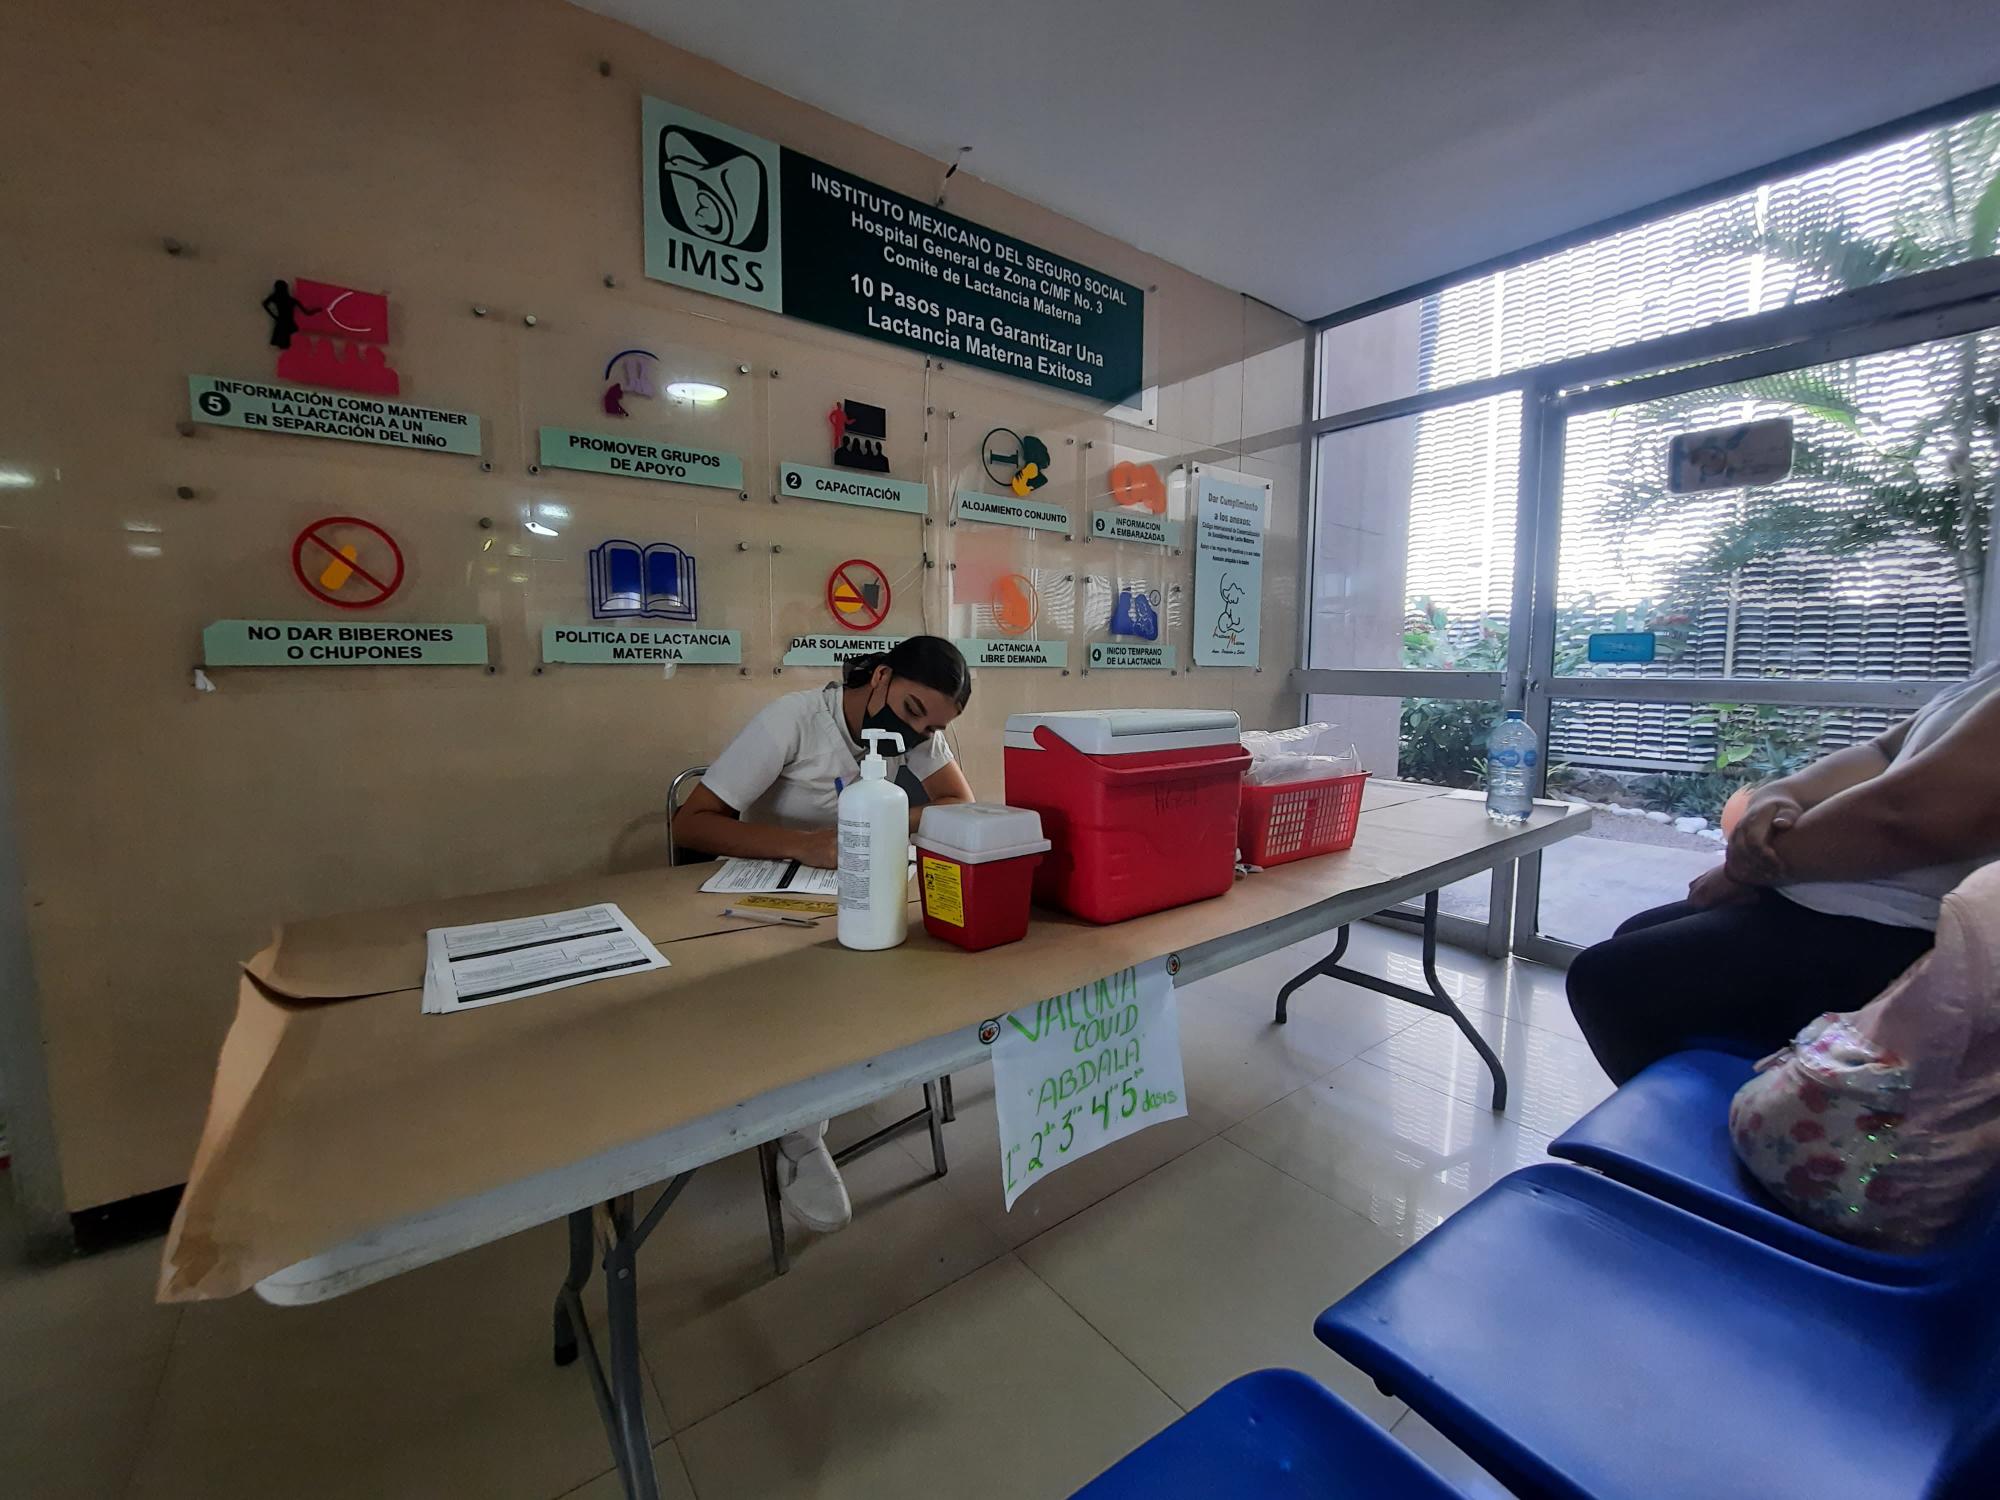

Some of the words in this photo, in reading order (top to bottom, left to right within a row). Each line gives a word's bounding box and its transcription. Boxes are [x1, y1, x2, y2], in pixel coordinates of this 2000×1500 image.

[811, 172, 903, 221] INSTITUTO
[908, 210, 991, 254] MEXICANO
[995, 243, 1023, 266] DEL
[1026, 255, 1081, 287] SEGURO
[1084, 277, 1127, 306] SOCIAL
[668, 238, 764, 292] IMSS
[851, 211, 918, 249] Hospital
[923, 238, 979, 271] General
[983, 260, 1000, 278] de
[1003, 266, 1036, 291] Zona
[1040, 280, 1071, 302] C/MF
[1074, 292, 1093, 312] No.
[1096, 301, 1103, 315] 3
[884, 246, 938, 277] Comite
[943, 268, 961, 285] de
[965, 274, 1030, 308] Lactancia
[1033, 297, 1082, 326] Materna
[851, 273, 874, 298] 10
[881, 282, 940, 318] Pasos
[946, 307, 985, 331] para
[991, 318, 1072, 357] Garantizar
[1077, 344, 1103, 367] Una
[868, 306, 960, 350] Lactancia
[966, 335, 1033, 370] Materna
[1038, 358, 1092, 387] Exitosa
[207, 391, 223, 412] 5
[214, 380, 333, 407] INFORMACIÓN
[337, 398, 384, 414] COMO
[388, 405, 468, 426] MANTENER
[272, 402, 294, 415] LA
[297, 405, 385, 427] LACTANCIA
[389, 417, 399, 429] A
[402, 419, 423, 432] UN
[244, 412, 267, 426] EN
[272, 415, 375, 440] SEPARACIÓN
[380, 429, 409, 443] DEL
[412, 432, 447, 448] NIÑO
[569, 435, 658, 459] PROMOVER
[660, 448, 720, 468] GRUPOS
[610, 457, 632, 471] DE
[634, 460, 686, 478] APOYO
[790, 475, 799, 487] 2
[815, 479, 901, 501] CAPACITACIÓN
[962, 500, 1022, 517] ALOJAMIENTO
[1024, 510, 1067, 524] CONJUNTO
[1208, 492, 1218, 504] Dar
[1220, 495, 1258, 512] Cumplimiento
[1220, 512, 1228, 523] los
[1110, 527, 1115, 535] A
[1117, 528, 1165, 542] EMBARAZADAS
[248, 626, 281, 640] NO
[287, 627, 332, 641] DAR
[338, 628, 453, 642] BIBERONES
[555, 630, 627, 644] POLITICA
[629, 632, 650, 645] DE
[654, 632, 731, 646] LACTANCIA
[792, 638, 817, 648] DAR
[820, 639, 885, 650] SOLAMENTE
[287, 646, 303, 659] O
[310, 646, 422, 660] CHUPONES
[612, 647, 683, 660] MATERNA
[987, 643, 1033, 653] LACTANCIA
[1034, 644, 1041, 653] A
[1106, 647, 1126, 655] INICIO
[1128, 647, 1162, 656] TEMPRANO
[980, 654, 1005, 664] LIBRE
[1007, 655, 1047, 664] DEMANDA
[1106, 657, 1115, 665] DE
